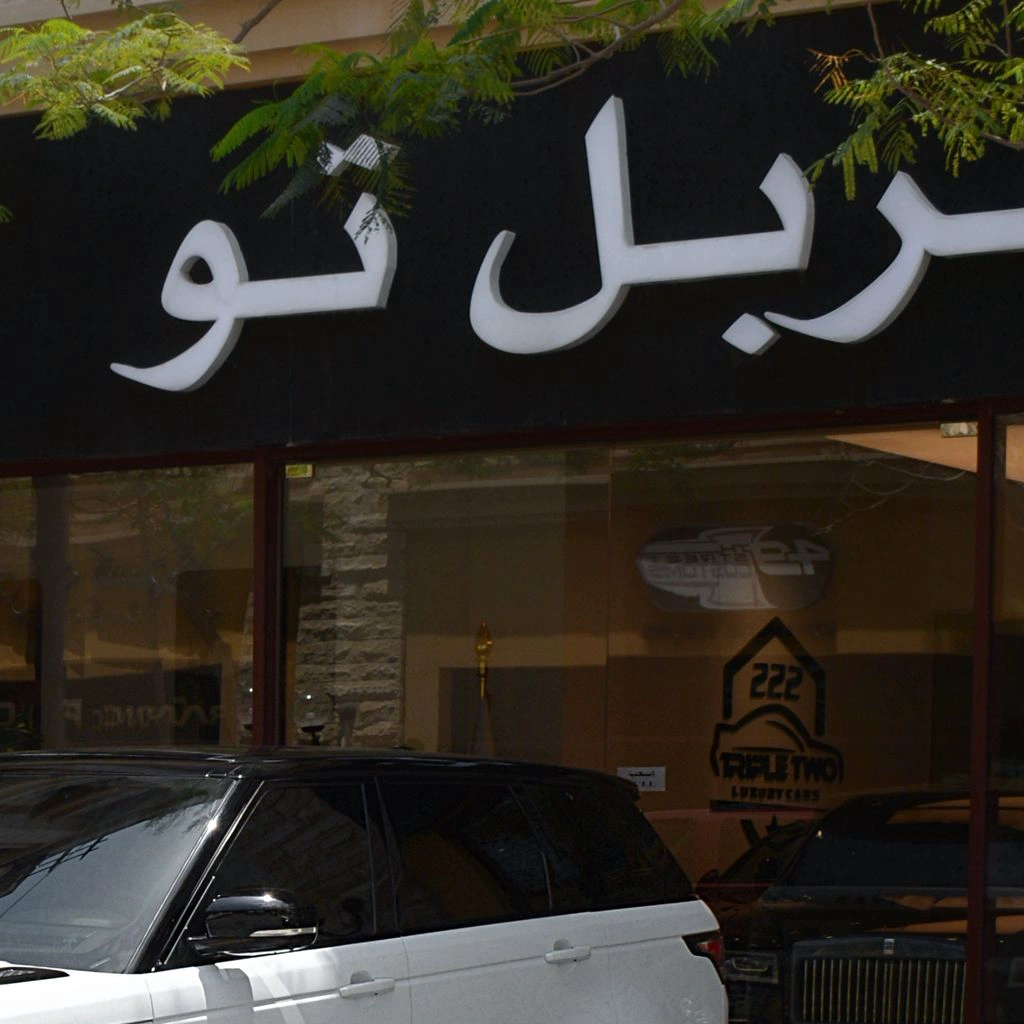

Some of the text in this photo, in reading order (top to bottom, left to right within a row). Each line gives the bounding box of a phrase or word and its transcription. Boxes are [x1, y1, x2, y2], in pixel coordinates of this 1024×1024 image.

[469, 95, 1024, 355] ربل
[749, 663, 804, 702] 222
[720, 752, 838, 783] TRIPLE TWO
